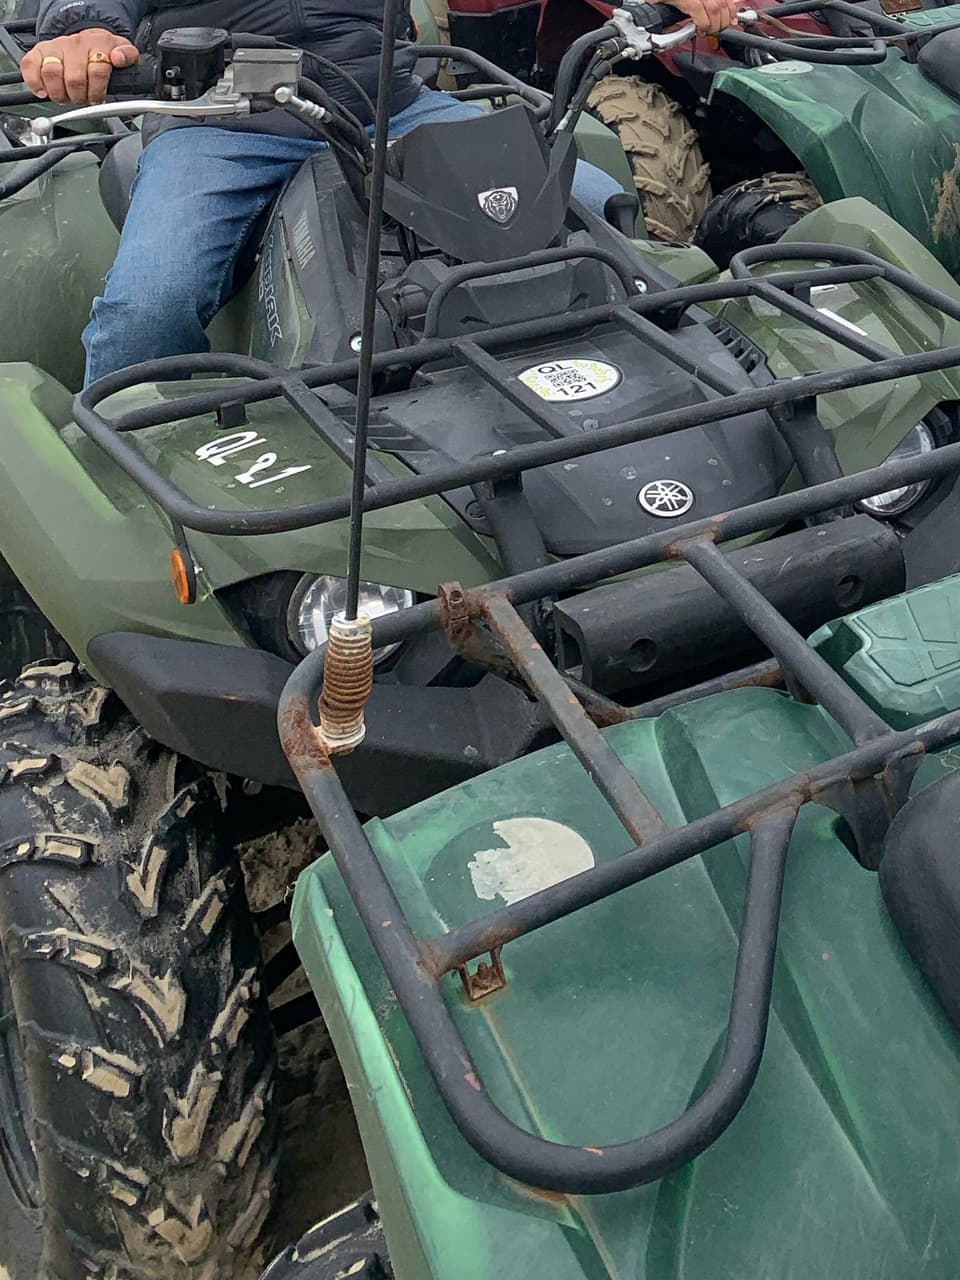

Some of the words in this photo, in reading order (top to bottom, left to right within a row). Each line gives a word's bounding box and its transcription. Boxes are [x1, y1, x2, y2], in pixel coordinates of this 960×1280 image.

[292, 210, 316, 271] YAMAHA
[537, 363, 573, 375] QL
[557, 382, 597, 396] 121
